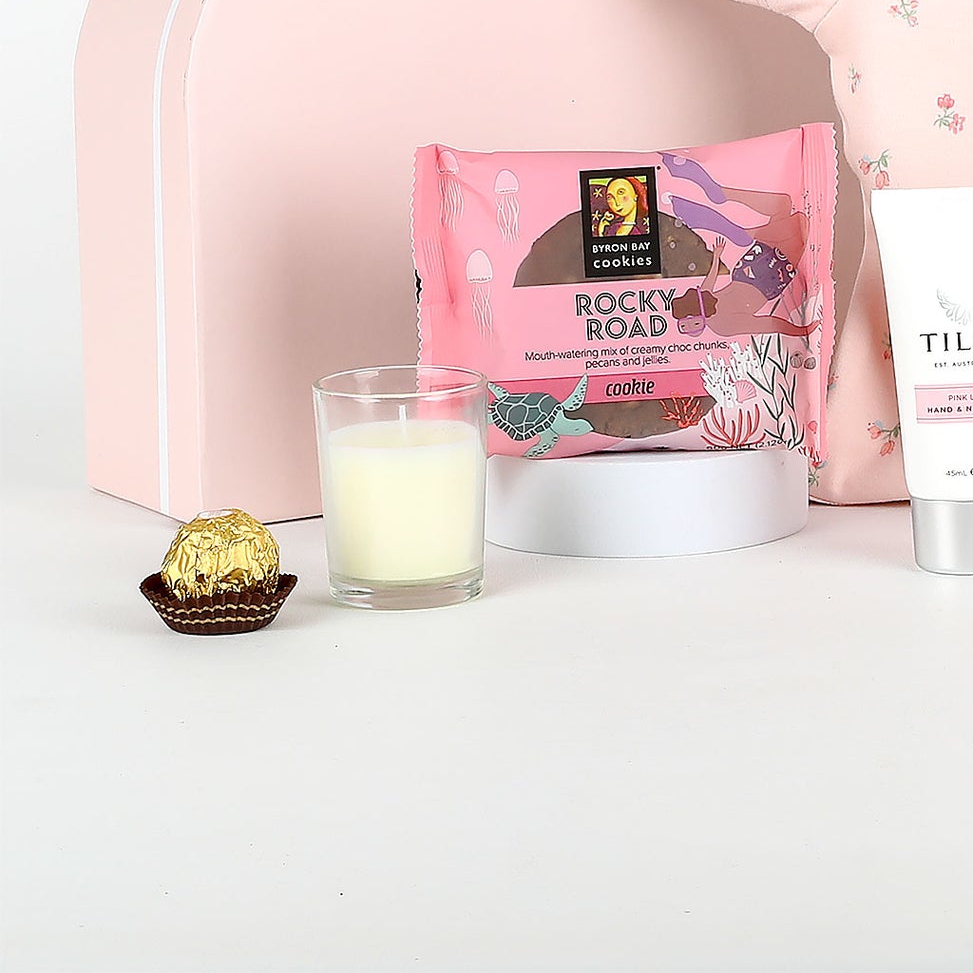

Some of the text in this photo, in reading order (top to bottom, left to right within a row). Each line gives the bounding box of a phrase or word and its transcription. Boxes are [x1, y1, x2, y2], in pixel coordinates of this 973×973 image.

[592, 241, 651, 254] BYRON BAY
[593, 255, 652, 269] cookies
[575, 287, 677, 317] ROCKY
[586, 314, 668, 341] ROAD
[524, 348, 599, 361] Mouth-watering
[600, 347, 618, 357] mix
[619, 345, 629, 356] of
[630, 346, 667, 356] creamy
[667, 343, 692, 353] choc
[585, 358, 621, 370] pecans
[622, 355, 641, 366] and
[605, 379, 655, 397] cookie
[948, 394, 968, 402] PINK
[927, 406, 953, 414] HAND
